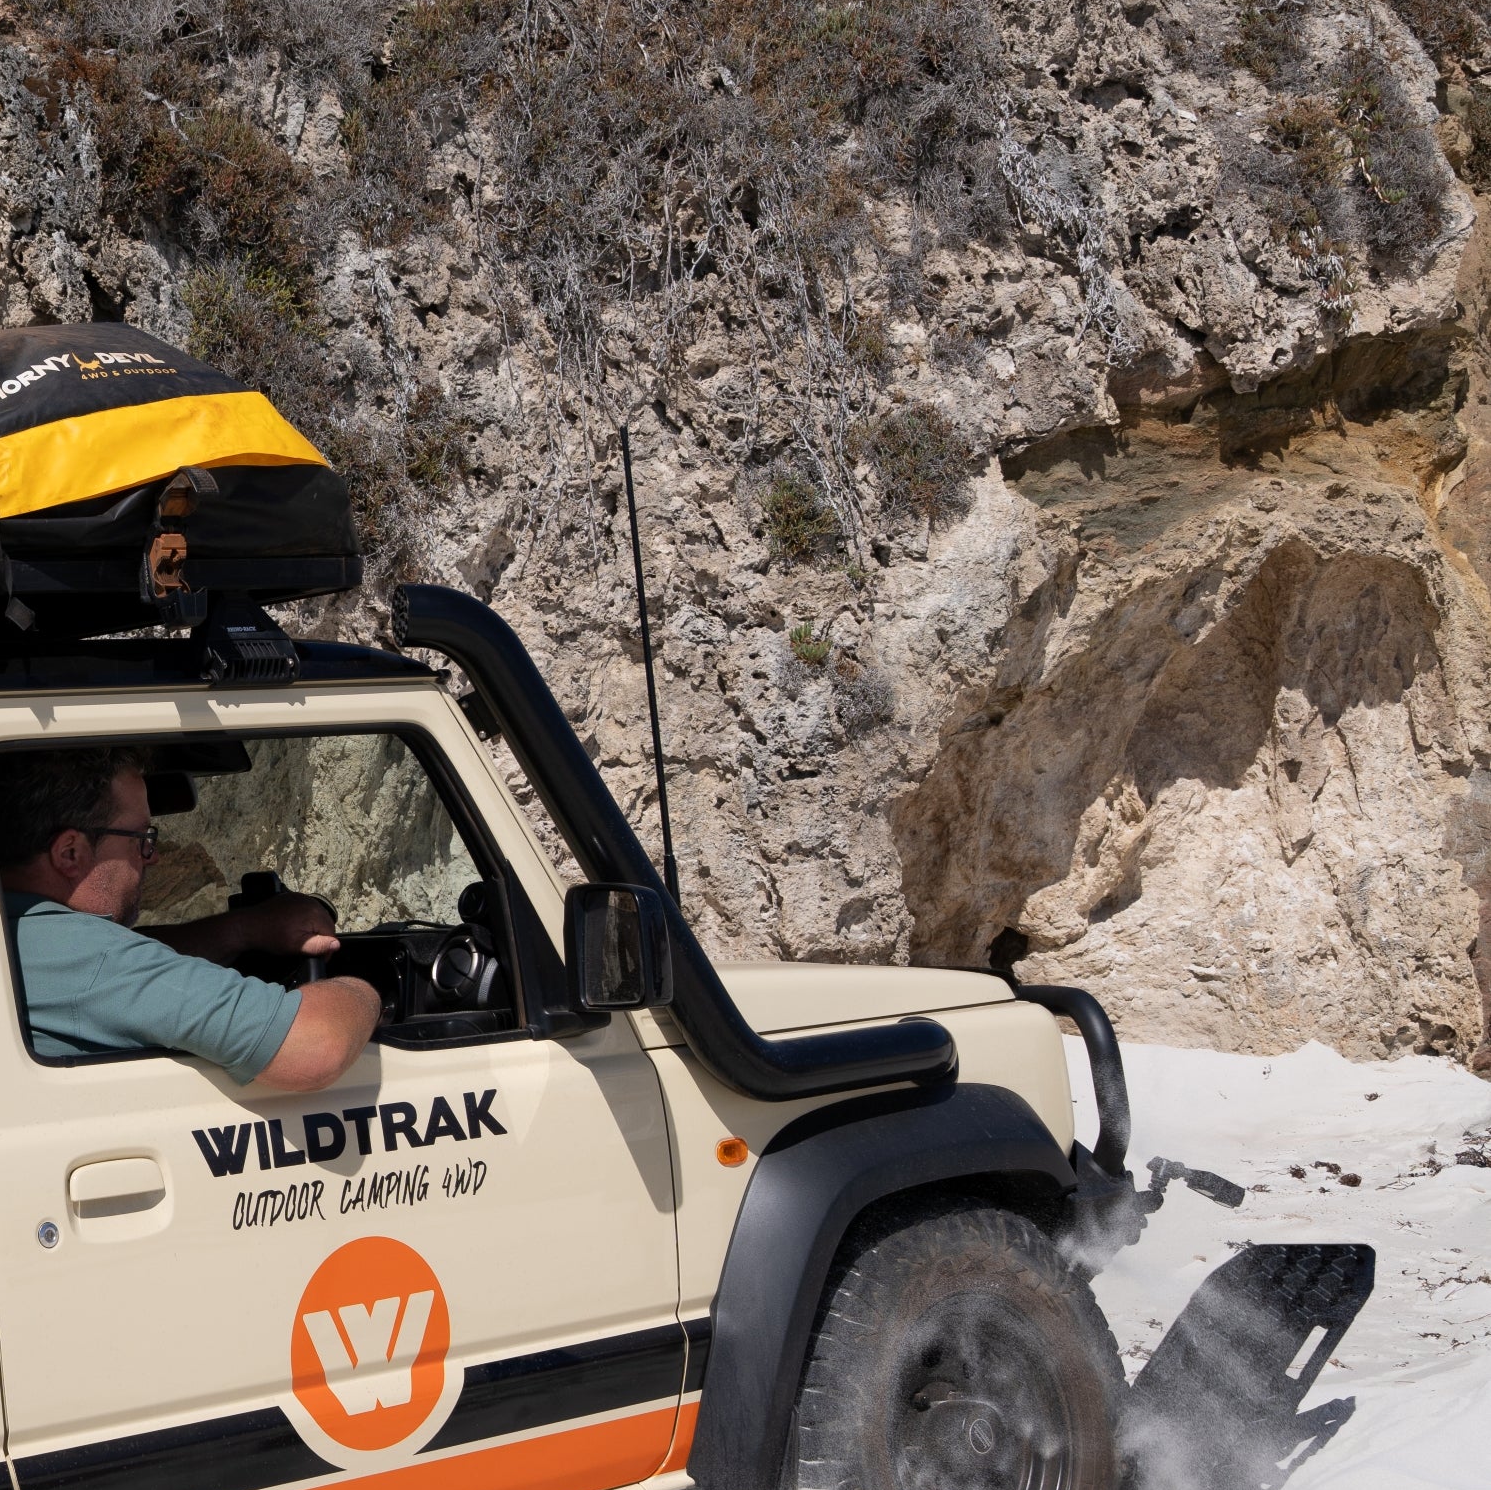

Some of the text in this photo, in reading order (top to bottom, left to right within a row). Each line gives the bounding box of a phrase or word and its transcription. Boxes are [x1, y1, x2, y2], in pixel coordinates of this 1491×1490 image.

[81, 371, 108, 381] 4WD
[123, 368, 179, 376] OUTDOOR
[94, 352, 166, 364] DEVIL
[191, 1088, 508, 1178] WILDTRAK
[232, 1157, 487, 1231] OUTDOOR CAMPING 4WD
